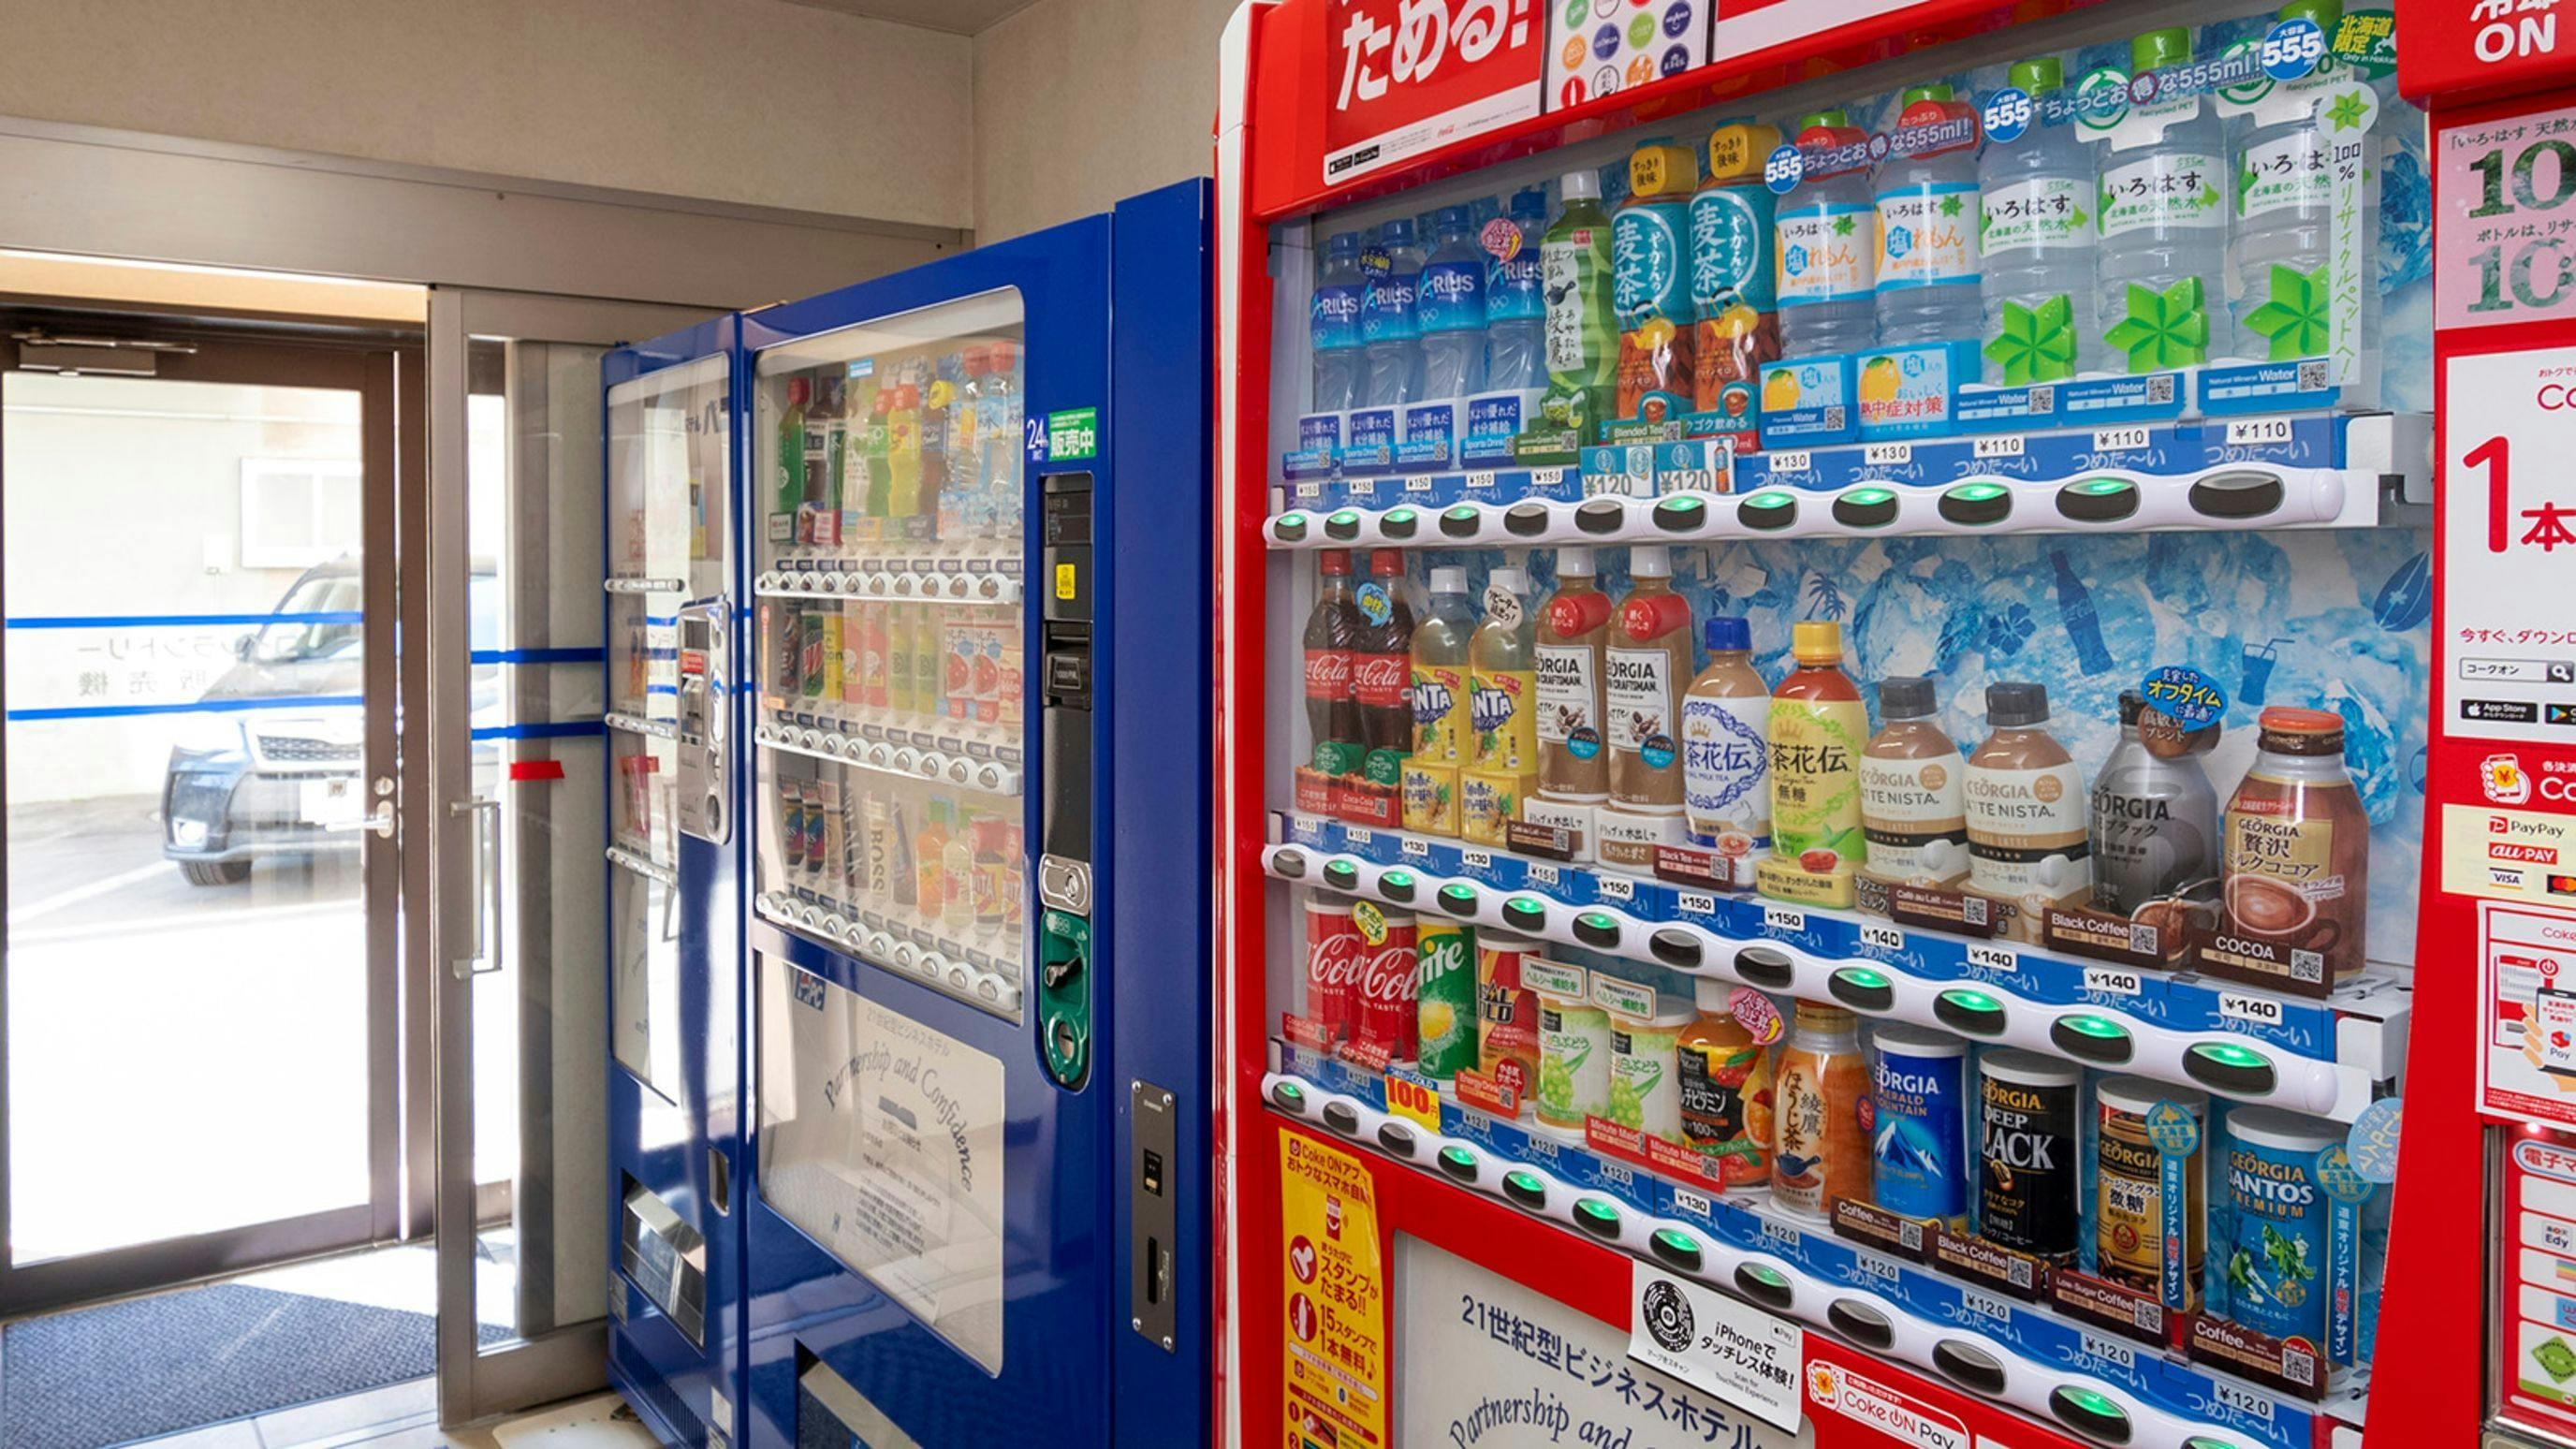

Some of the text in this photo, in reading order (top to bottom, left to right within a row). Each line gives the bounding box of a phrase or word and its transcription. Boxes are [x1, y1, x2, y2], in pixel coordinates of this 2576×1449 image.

[2262, 30, 2321, 66] 555
[2474, 13, 2556, 63] ON
[1983, 100, 2031, 129] 555
[1764, 154, 1803, 183] 555
[1694, 203, 1727, 292] 麦茶
[1616, 220, 1647, 306] 麦茶
[2259, 368, 2296, 381] Water
[2113, 381, 2146, 394] Water
[1860, 396, 1943, 418] 熱中症対策
[1998, 394, 2028, 404] Water
[1614, 426, 1647, 438] Blended
[2100, 430, 2144, 446] ¥110
[2235, 422, 2287, 439] ¥110
[1049, 426, 1095, 459] 販売中
[1980, 438, 2020, 454] ¥110
[1774, 455, 1807, 468] ¥130
[1870, 446, 1908, 461] ¥130
[1468, 474, 1493, 486] ¥150
[1535, 470, 1561, 482] ¥150
[1584, 474, 1632, 496] ¥120
[1661, 470, 1712, 494] ¥120
[2466, 664, 2520, 676] コークオン
[2147, 681, 2222, 709] オフタイム
[2483, 703, 2526, 715] App Store
[2238, 817, 2301, 840] GEORGIA
[2510, 820, 2566, 839] PayPay
[1660, 848, 1693, 864] Black Tea
[2243, 832, 2291, 859] 贅沢
[2491, 844, 2555, 863] au PAY
[1464, 853, 1488, 866] ¥130
[1531, 868, 1556, 882] ¥150
[2494, 872, 2521, 885] VISA
[1602, 882, 1630, 895] ¥150
[1682, 896, 1712, 911] ¥150
[1767, 911, 1801, 928] ¥150
[2052, 913, 2130, 938] Black Coffee
[1863, 929, 1899, 946] ¥140
[1970, 949, 2013, 968] ¥140
[2216, 936, 2276, 961] COCOA
[2088, 973, 2136, 991] ¥140
[2224, 998, 2277, 1018] ¥140
[2550, 1046, 2570, 1061] Pay
[1412, 1075, 1434, 1090] COLD
[1784, 1069, 1806, 1152] ほうじ茶
[893, 1057, 922, 1085] and
[922, 1069, 973, 1193] Confidence
[1302, 1143, 1326, 1169] Coke
[1530, 1138, 1556, 1155] ¥120
[1602, 1164, 1631, 1183] ¥120
[2230, 1150, 2305, 1184] GEORGIA
[2228, 1172, 2315, 1206] SANTOS
[1676, 1193, 1708, 1213] ¥130
[1838, 1201, 1874, 1222] Coffee
[2109, 1191, 2145, 1215] 微糖
[2230, 1190, 2305, 1219] PREMIUM
[1764, 1222, 1798, 1244] ¥120
[2545, 1233, 2569, 1250] Edy
[1937, 1233, 2007, 1269] Black Coffee
[1320, 1255, 1379, 1300] スタンプが
[1859, 1256, 1896, 1280] ¥120
[1965, 1292, 2007, 1319] ¥120
[2097, 1290, 2135, 1311] Coffee
[1715, 1321, 1777, 1360] iPhoneで
[2195, 1321, 2245, 1348] Coffee
[2085, 1336, 2130, 1365] ¥120
[1701, 1336, 1795, 1391] タッチレス体験!
[2217, 1383, 2269, 1417] ¥120
[1449, 1388, 1633, 1449] Partnership and
[1844, 1390, 1887, 1422] Coke
[1889, 1412, 1916, 1435] ON
[1920, 1422, 1955, 1449] Pay
